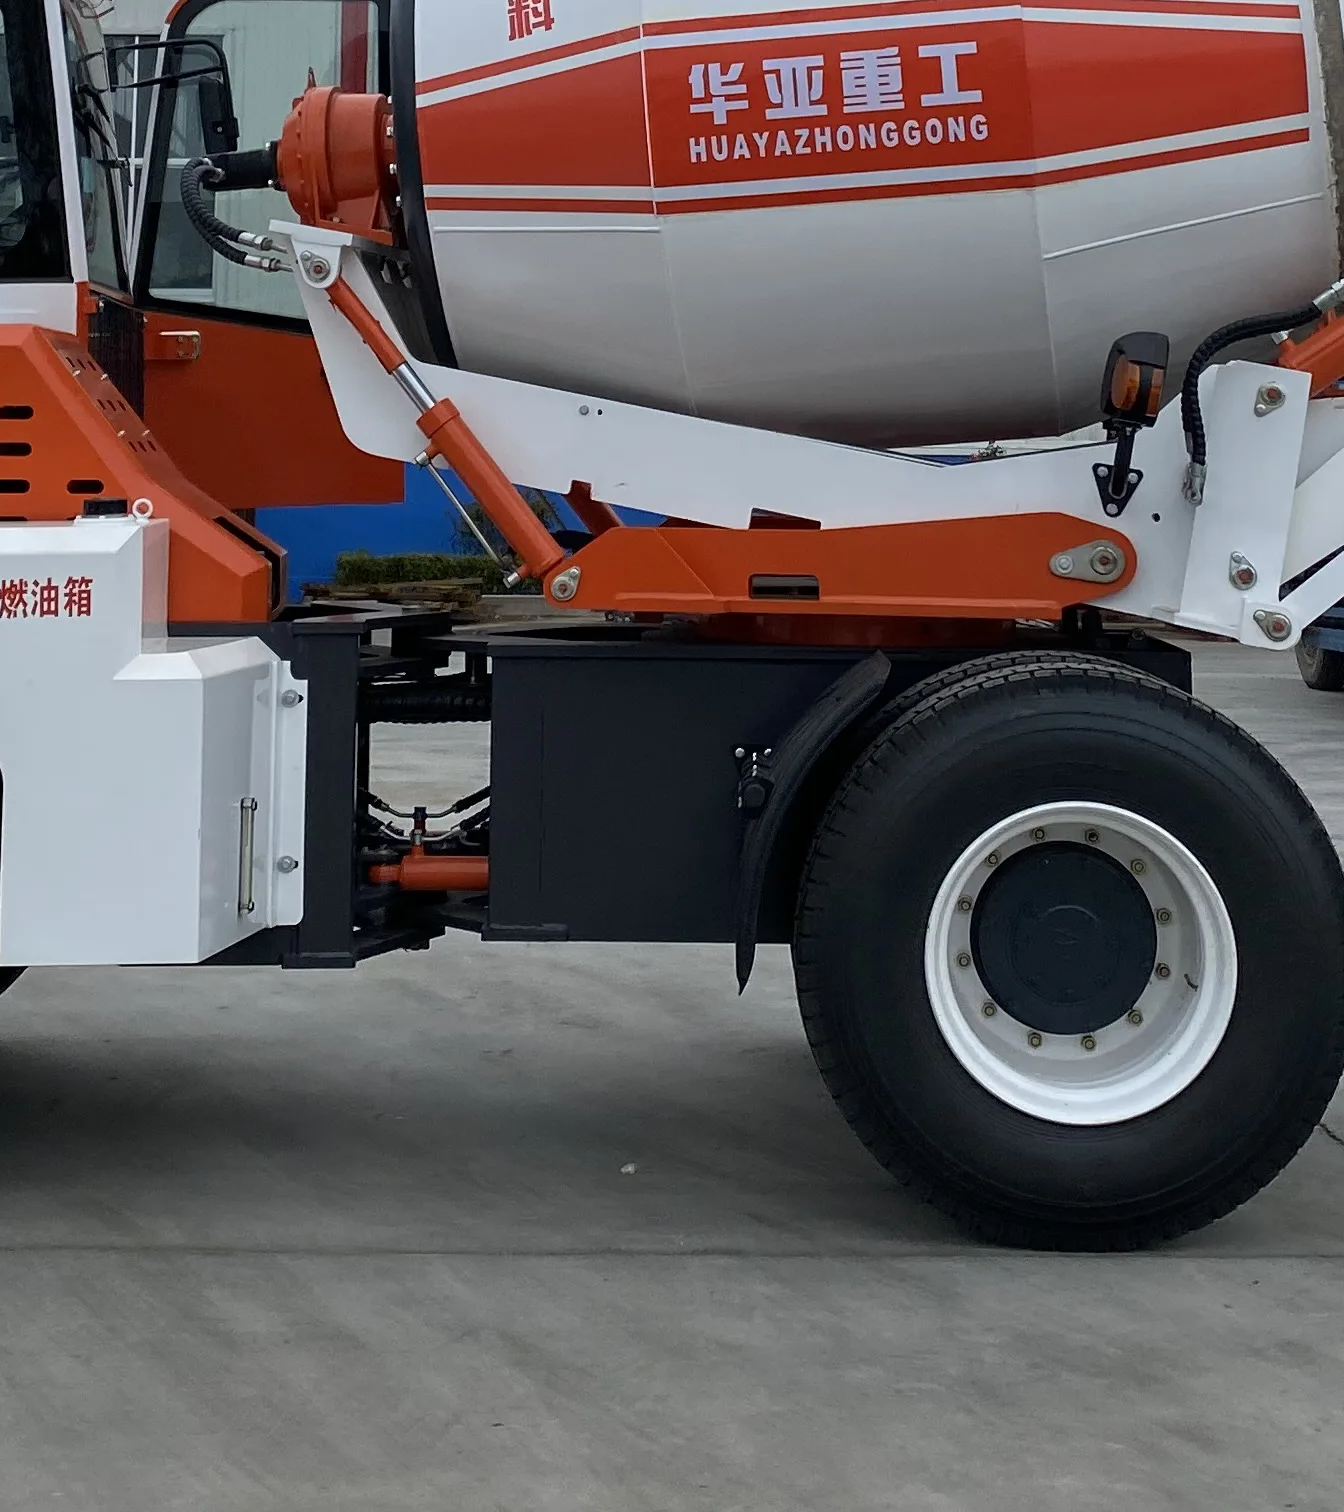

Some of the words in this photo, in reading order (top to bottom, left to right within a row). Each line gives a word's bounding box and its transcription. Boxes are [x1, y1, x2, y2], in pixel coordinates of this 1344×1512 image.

[688, 41, 983, 125] 华亚重工
[689, 114, 989, 163] HUAYAZHONGGONG
